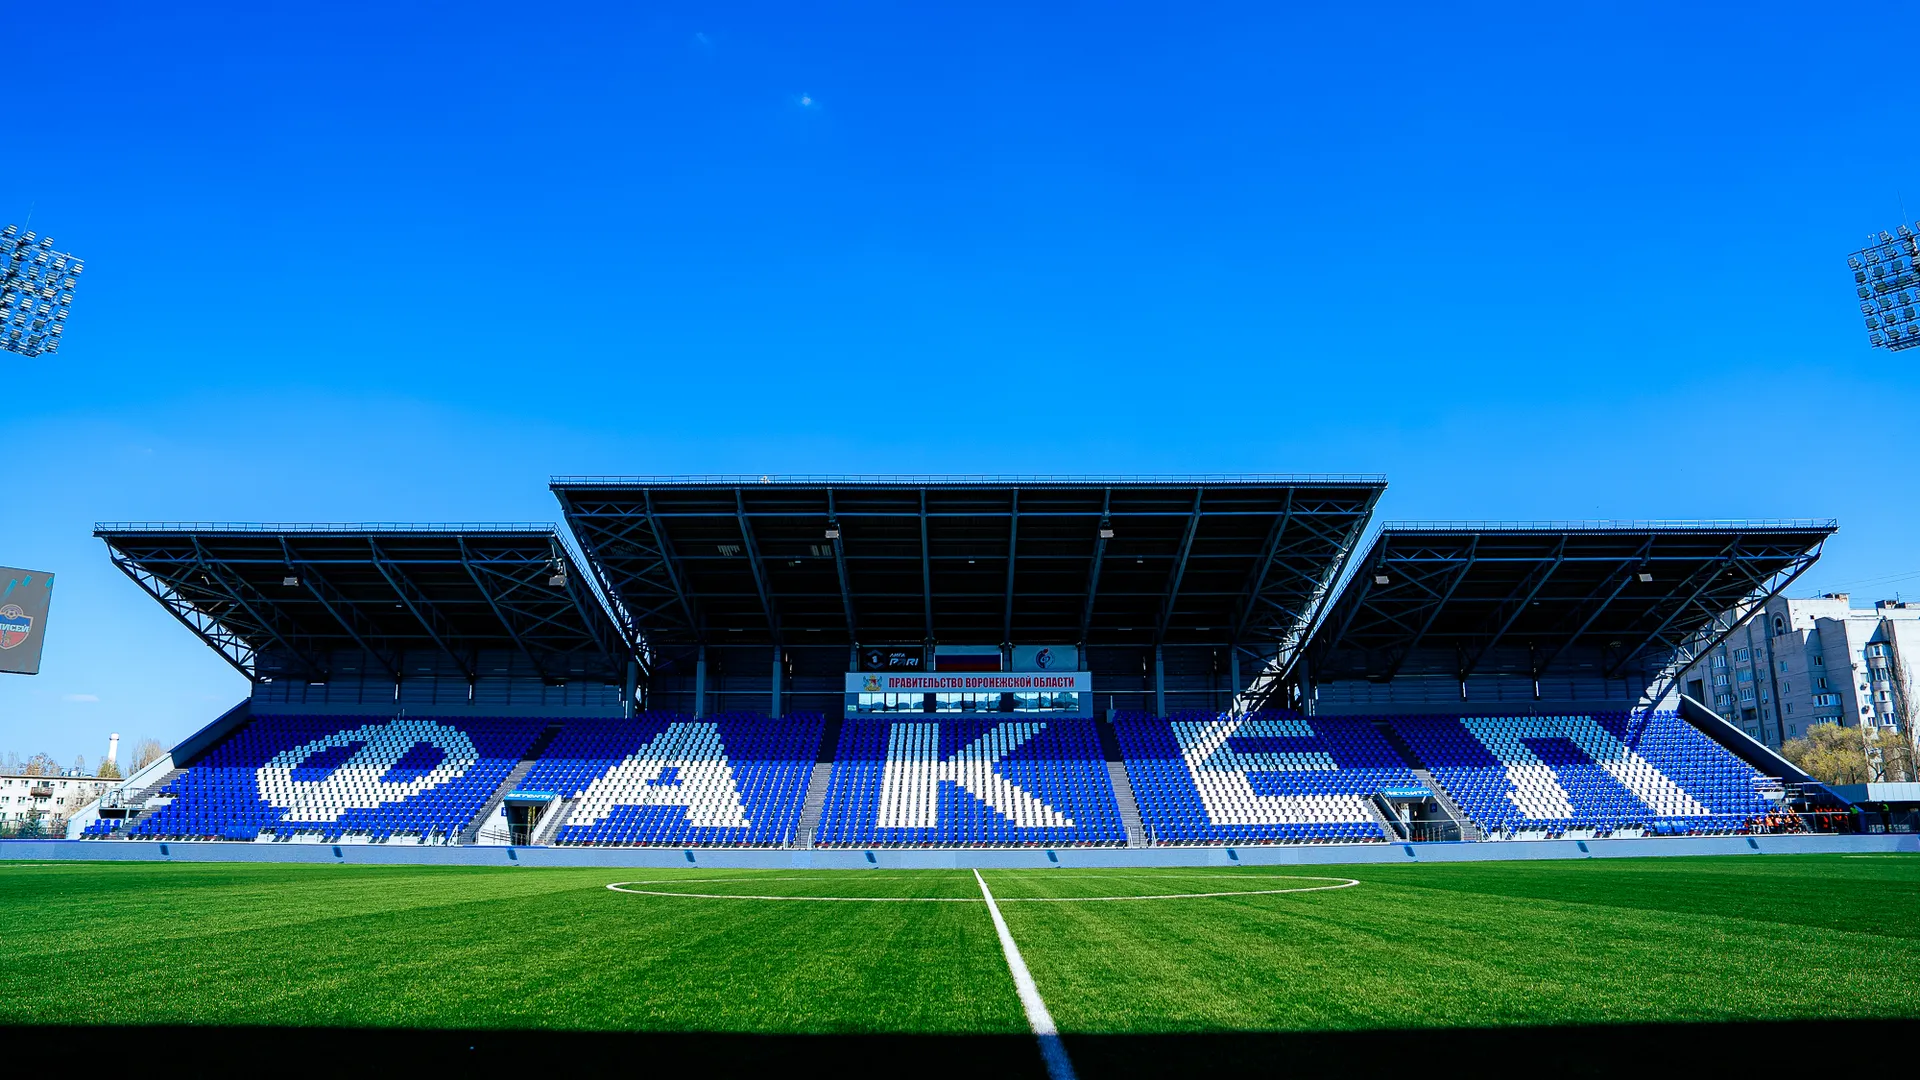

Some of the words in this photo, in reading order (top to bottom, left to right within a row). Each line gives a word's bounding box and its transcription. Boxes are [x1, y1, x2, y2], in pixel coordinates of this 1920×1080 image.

[888, 677, 963, 688] ПРАВИТЕЛЬСТВО
[965, 676, 1031, 688] ВОРОНЕЖСКОЙ
[1033, 677, 1075, 688] ОБЛАСТИ
